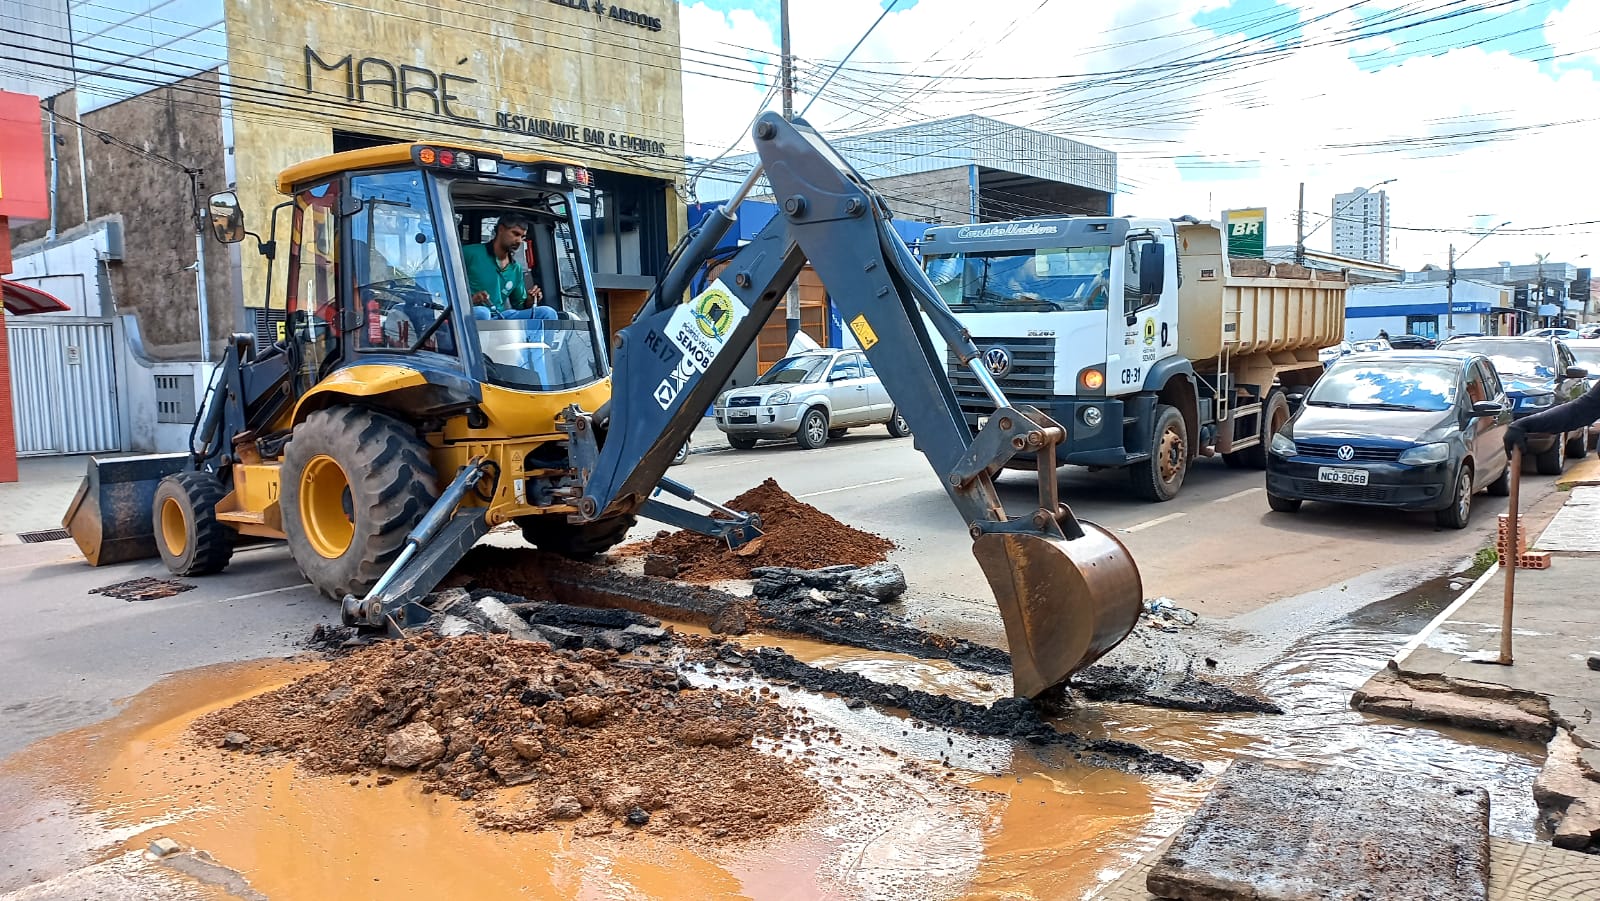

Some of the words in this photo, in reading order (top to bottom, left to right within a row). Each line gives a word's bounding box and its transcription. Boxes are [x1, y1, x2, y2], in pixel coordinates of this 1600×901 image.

[608, 5, 662, 31] ARTOIS
[305, 44, 480, 123] MARÉ
[496, 111, 580, 142] RESTAURANTE
[583, 127, 605, 145] BAR
[608, 132, 617, 147] &
[620, 135, 666, 154] EVENTOS
[1231, 222, 1259, 236] BR
[676, 331, 710, 368] SEMOB
